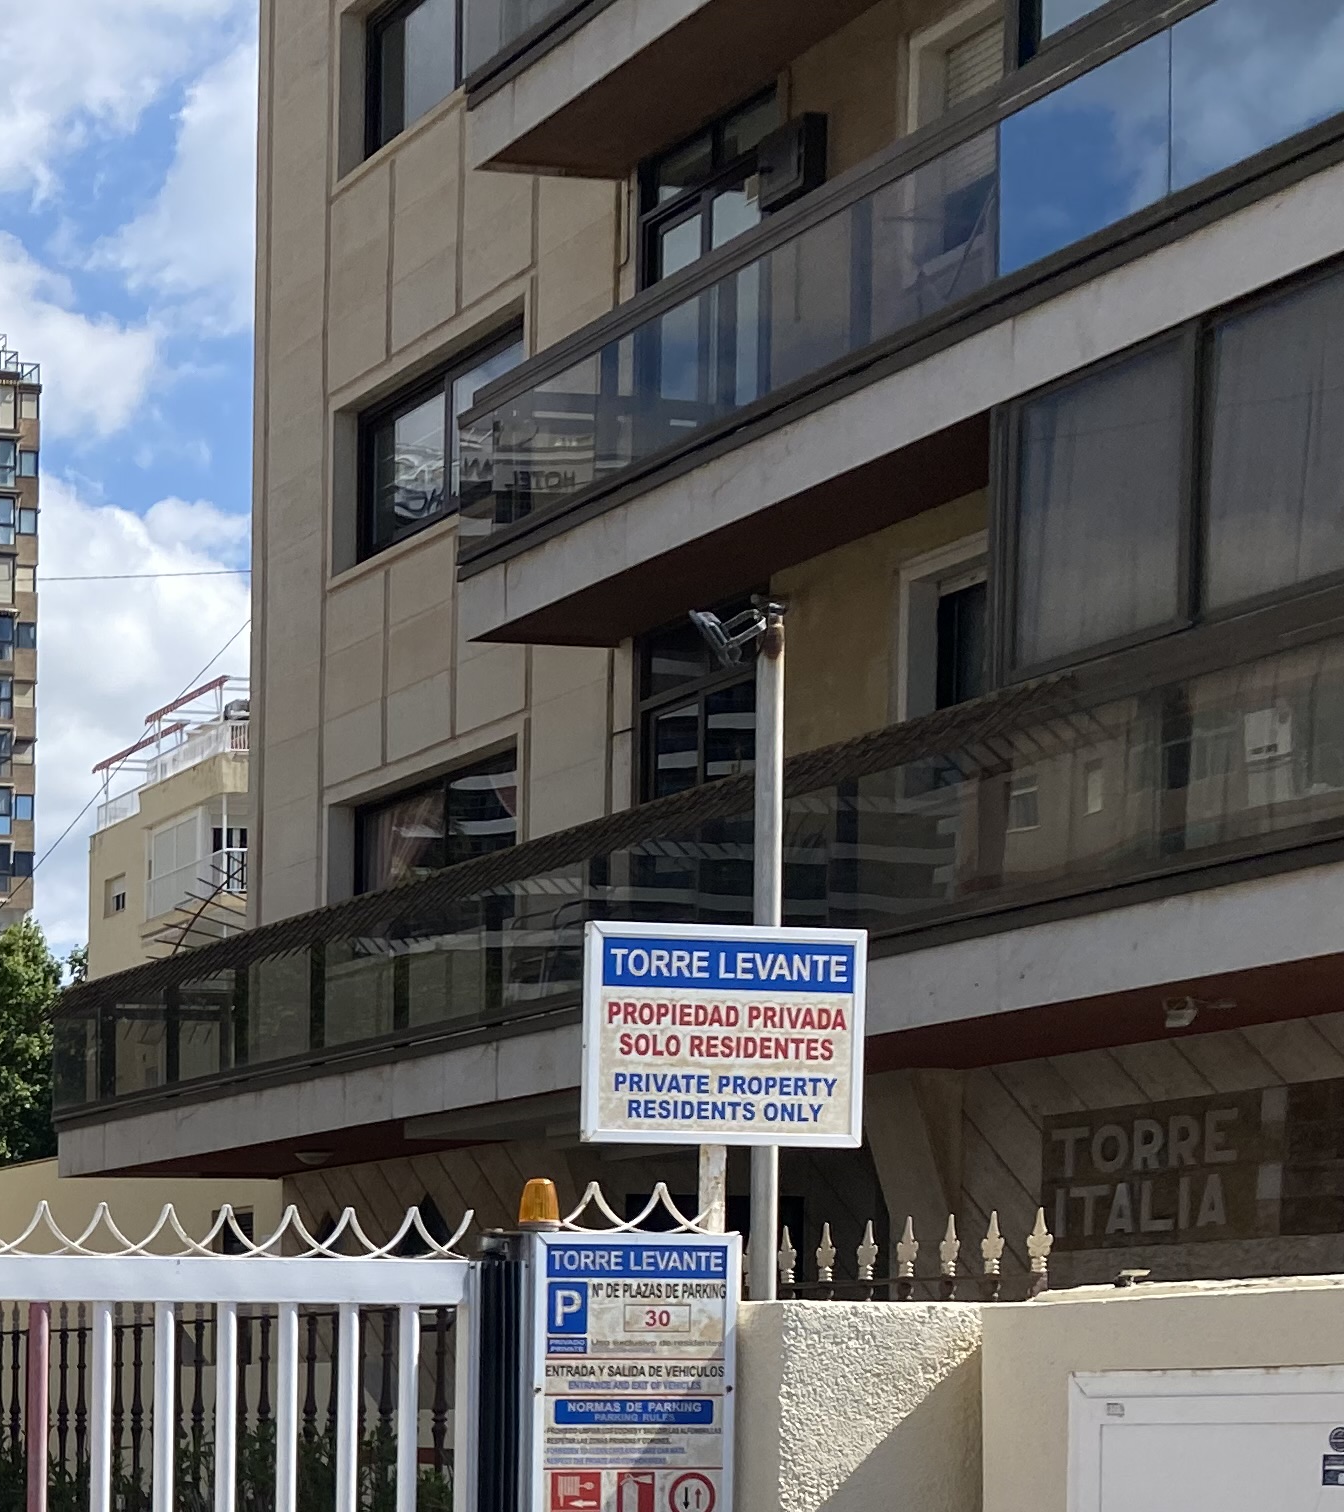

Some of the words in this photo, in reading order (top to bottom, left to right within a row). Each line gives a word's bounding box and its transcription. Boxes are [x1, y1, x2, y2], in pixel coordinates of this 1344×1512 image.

[610, 948, 710, 978] TORRE
[718, 951, 849, 983] LEVANTE
[607, 1001, 740, 1027] PROPIEDAD
[747, 1005, 848, 1031] PRIVADA
[618, 1033, 681, 1057] SOLO
[689, 1034, 834, 1061] RESIDENTES
[614, 1072, 710, 1094] PRIVATE
[717, 1075, 838, 1098] PROPERTY
[627, 1099, 756, 1121] RESIDENTS
[763, 1103, 824, 1123] ONLY
[1051, 1107, 1239, 1178] TORRE
[1054, 1173, 1227, 1237] ITALIA
[551, 1250, 623, 1271] TORRE
[629, 1251, 724, 1272] LEVANTE
[606, 1283, 619, 1298] DE
[623, 1283, 662, 1299] PLAZAS
[665, 1284, 679, 1299] DE
[682, 1284, 726, 1299] PARKING
[555, 1289, 582, 1327] P
[645, 1310, 671, 1327] 30
[545, 1365, 596, 1377] ENTRADA
[598, 1365, 606, 1377] Y
[607, 1365, 646, 1377] SALIDA
[648, 1365, 662, 1377] DE
[664, 1365, 725, 1378] VEHICULOS
[567, 1402, 621, 1412] NORMAS
[626, 1402, 643, 1412] DE
[647, 1402, 702, 1412] PARKING
[594, 1413, 638, 1422] PARKING
